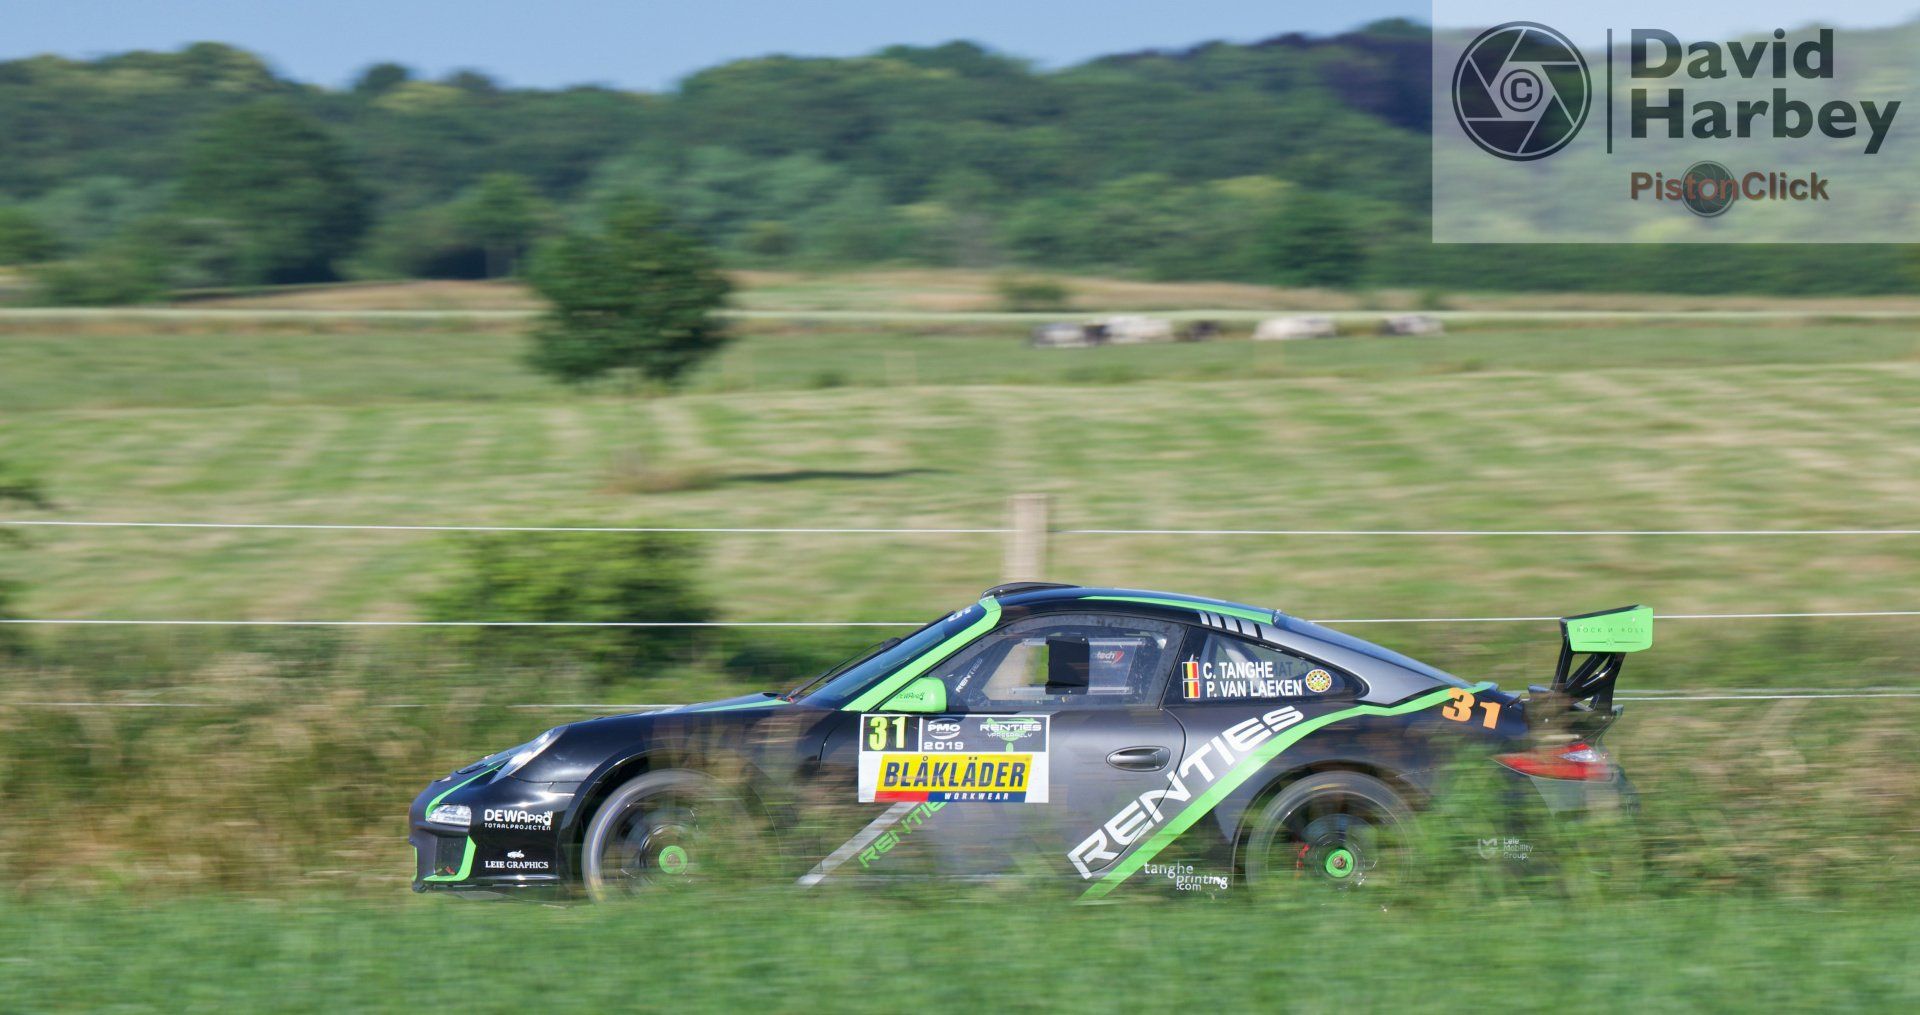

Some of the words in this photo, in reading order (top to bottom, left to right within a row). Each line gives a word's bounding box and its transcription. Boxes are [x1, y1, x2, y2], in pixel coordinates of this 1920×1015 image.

[1203, 664, 1216, 679] C.
[1219, 661, 1273, 679] TANGHE
[1206, 681, 1217, 697] P.
[1220, 681, 1247, 697] VAN
[1250, 679, 1303, 697] LAEKEN
[1442, 687, 1501, 730] 31
[869, 716, 906, 751] 31
[927, 723, 961, 732] PMO
[979, 724, 1042, 732] RENTIES
[923, 741, 964, 750] 2019
[884, 755, 1026, 788] BLÅKLÄDER
[944, 792, 1009, 800] WORKWEAR
[1067, 705, 1304, 880] RENTIES
[485, 860, 505, 869] LEIE
[506, 860, 549, 869] GRAPHICS
[1144, 860, 1194, 879] tanghe
